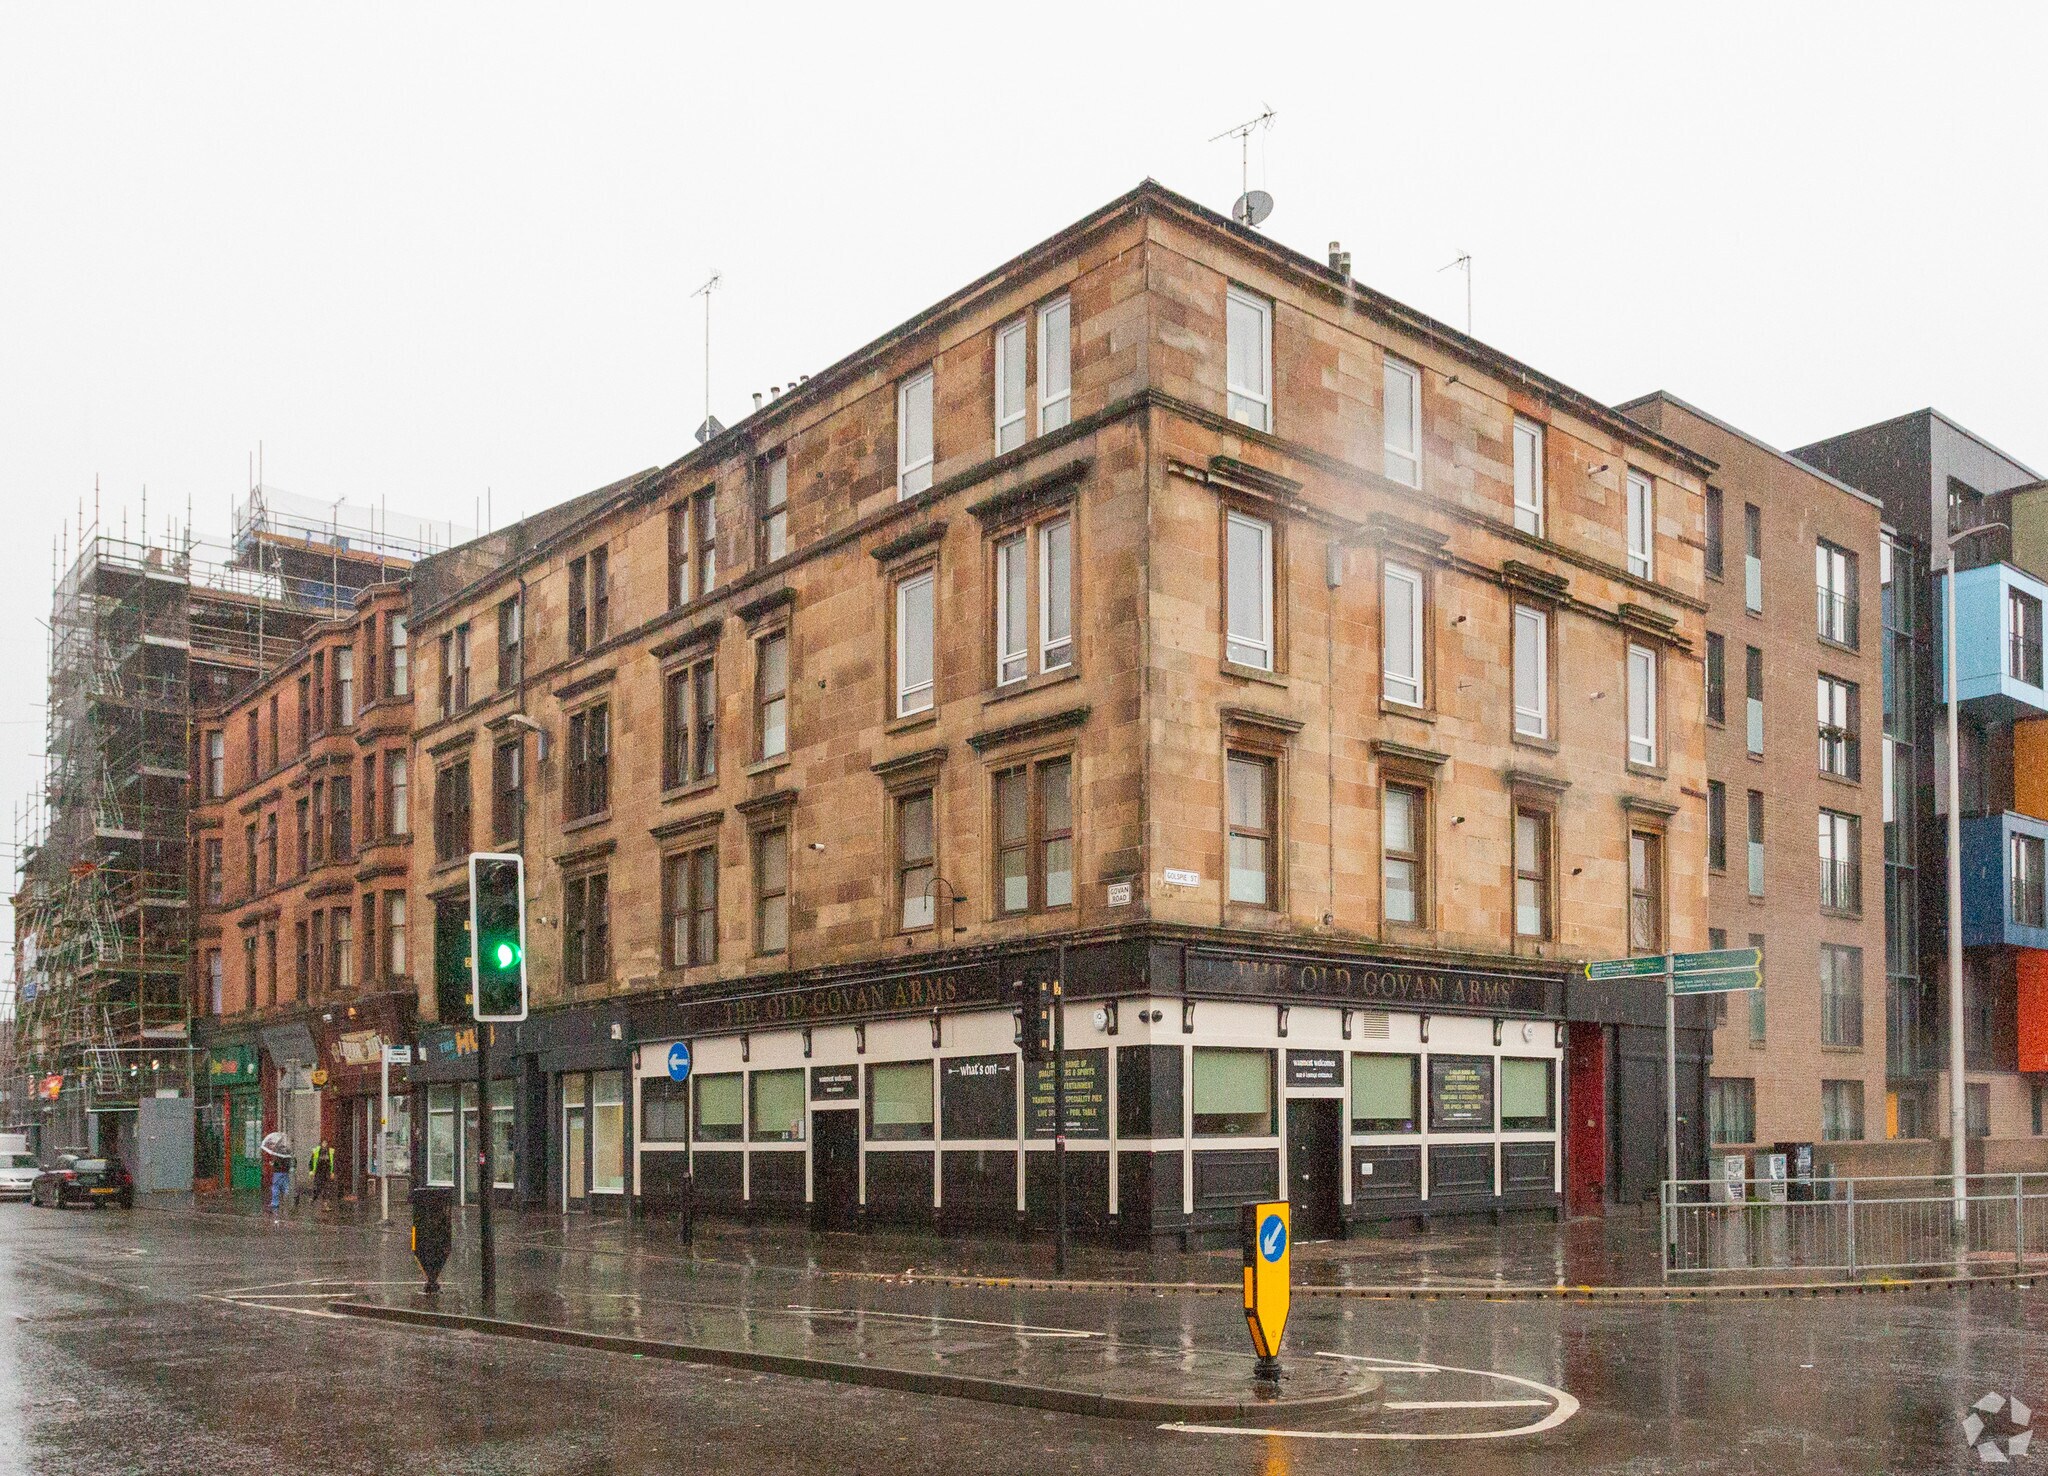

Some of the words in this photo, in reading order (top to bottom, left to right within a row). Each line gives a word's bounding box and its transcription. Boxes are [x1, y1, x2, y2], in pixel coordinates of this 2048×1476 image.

[1166, 872, 1187, 881] GOLSPIE
[1110, 886, 1129, 895] GOVAN
[1112, 894, 1127, 903] ROAD
[1233, 960, 1287, 990] THE
[1300, 964, 1351, 994] OLD
[1363, 971, 1444, 1001] GOVAN
[1453, 978, 1511, 1004] ARMS
[723, 999, 758, 1024] THE
[767, 994, 805, 1019] OLD
[813, 984, 885, 1014] GOVAN
[895, 976, 957, 1006] ARMS
[960, 1063, 984, 1076] what's
